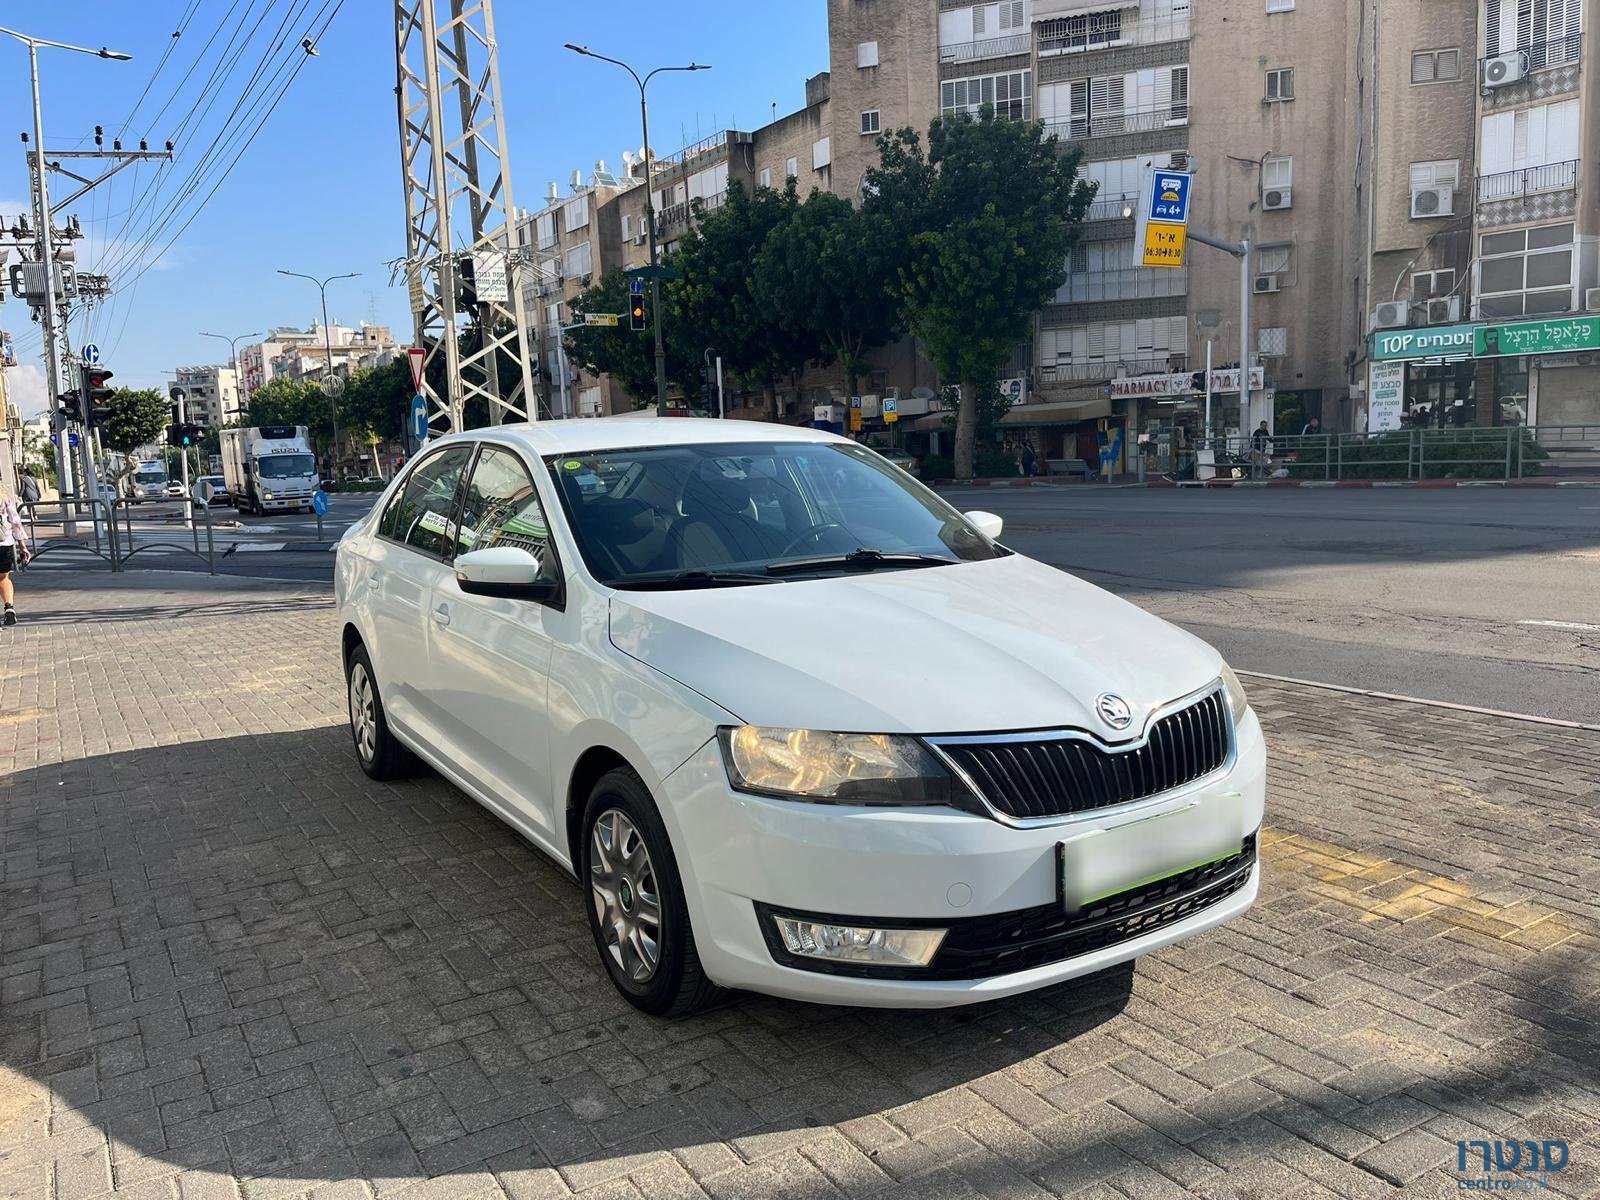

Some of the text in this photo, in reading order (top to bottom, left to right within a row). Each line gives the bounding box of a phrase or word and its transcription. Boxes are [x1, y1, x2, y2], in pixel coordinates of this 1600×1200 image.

[1169, 205, 1180, 215] 4+
[1381, 332, 1472, 353] מטבחים TOP
[1111, 380, 1167, 394] PHARMACY
